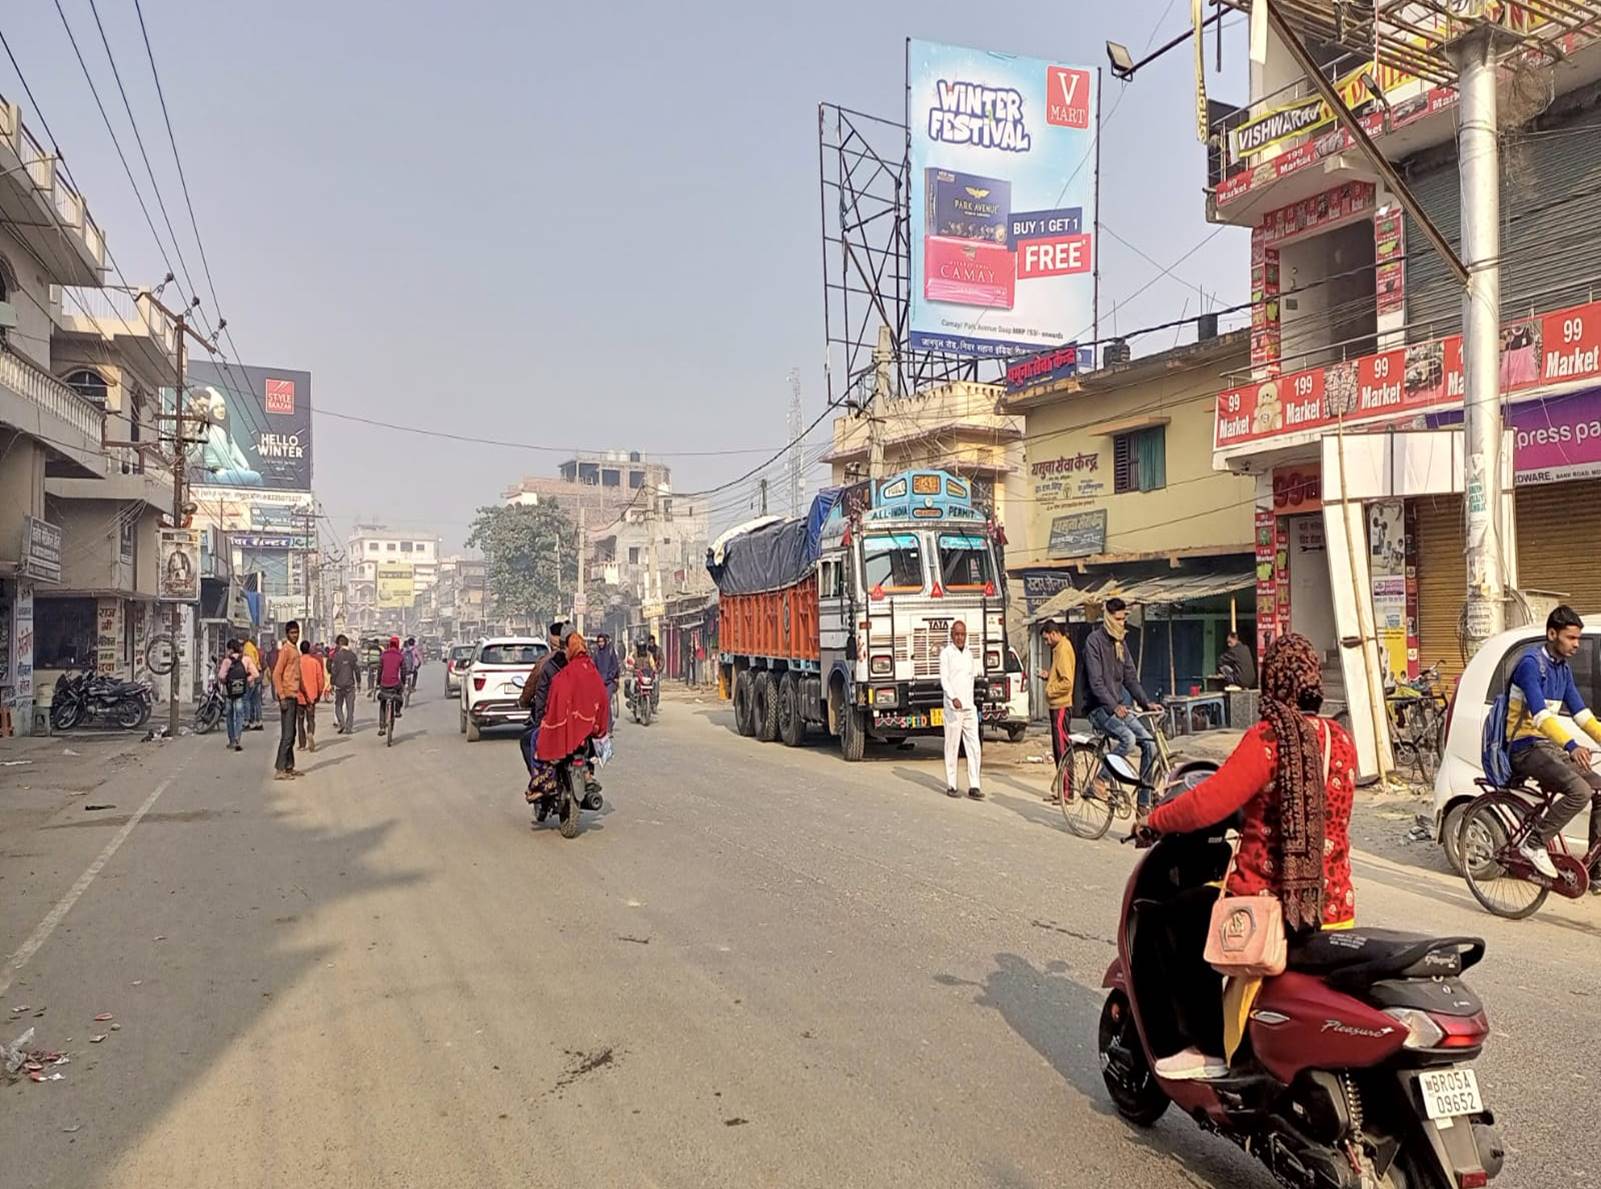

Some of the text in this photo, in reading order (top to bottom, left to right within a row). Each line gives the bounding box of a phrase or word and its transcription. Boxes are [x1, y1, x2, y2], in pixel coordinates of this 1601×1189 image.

[1057, 72, 1080, 106] V
[937, 79, 1023, 121] WINTER
[1050, 104, 1086, 125] MART
[928, 107, 1031, 152] FESTIVAL
[1238, 101, 1321, 151] VISHWARAJ
[1280, 154, 1311, 174] Market
[1287, 147, 1303, 161] 199
[1219, 183, 1247, 203] Market
[954, 198, 973, 211] PARK
[974, 202, 1000, 215] AVENUE
[1013, 217, 1079, 235] BUY 1 GET 1
[940, 264, 996, 283] CAMAY
[1563, 317, 1582, 343] 99
[1374, 357, 1388, 378] 99
[1545, 344, 1600, 379] Market
[1294, 375, 1313, 396] 199
[1361, 381, 1401, 409] Market
[1228, 393, 1240, 412] 99
[1286, 397, 1320, 424] Market
[1219, 414, 1249, 438] Market
[261, 433, 298, 446] HELLO
[257, 443, 304, 458] WINTER
[1516, 471, 1554, 484] DWARE,
[871, 505, 907, 520] ALL-INDIA
[948, 505, 975, 519] PERMIT
[928, 620, 949, 630] TATA
[1431, 1071, 1471, 1093] BR05A
[1437, 1092, 1477, 1114] 09652
